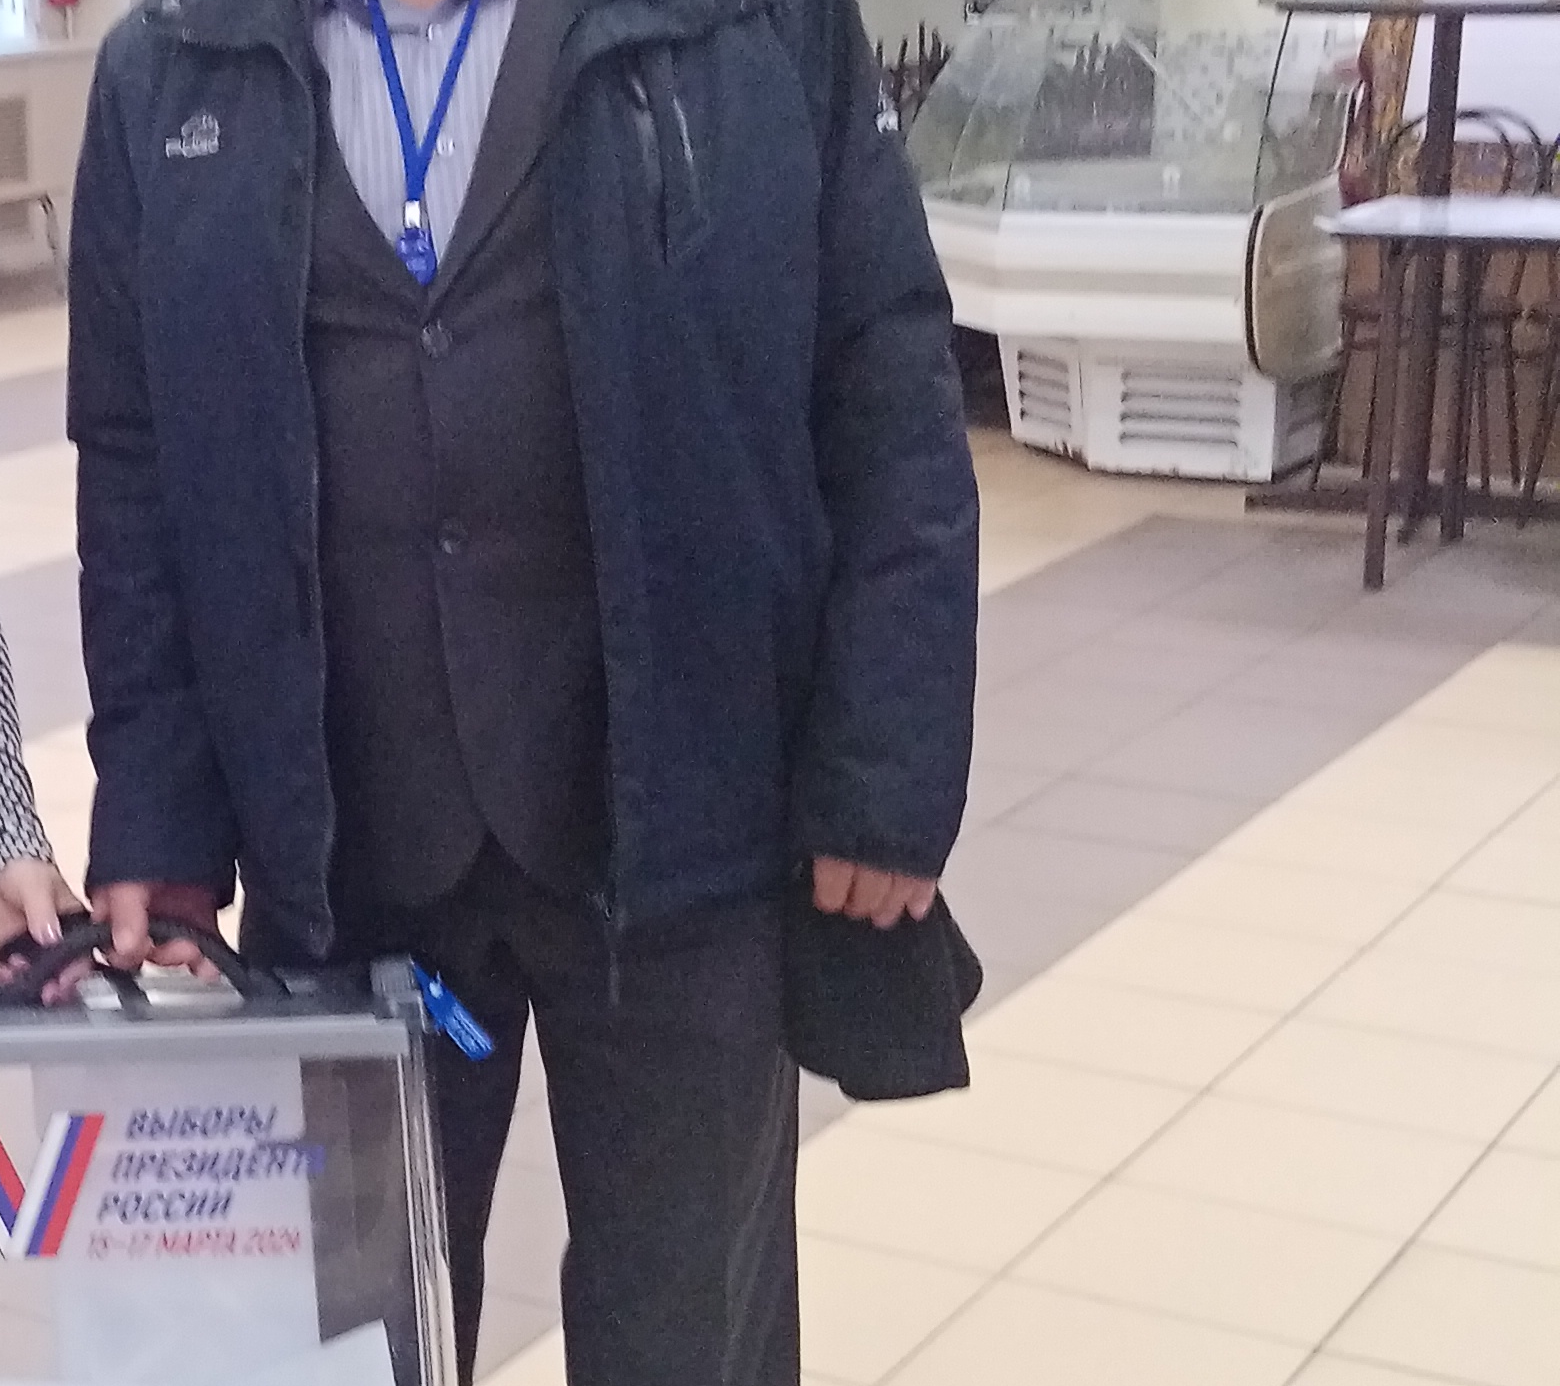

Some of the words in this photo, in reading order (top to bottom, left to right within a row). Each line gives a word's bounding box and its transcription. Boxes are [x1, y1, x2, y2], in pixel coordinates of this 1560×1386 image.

[125, 1104, 278, 1141] ВЫБОРЫ
[95, 1188, 234, 1226] РОССИИ
[155, 1227, 236, 1258] МАРТА
